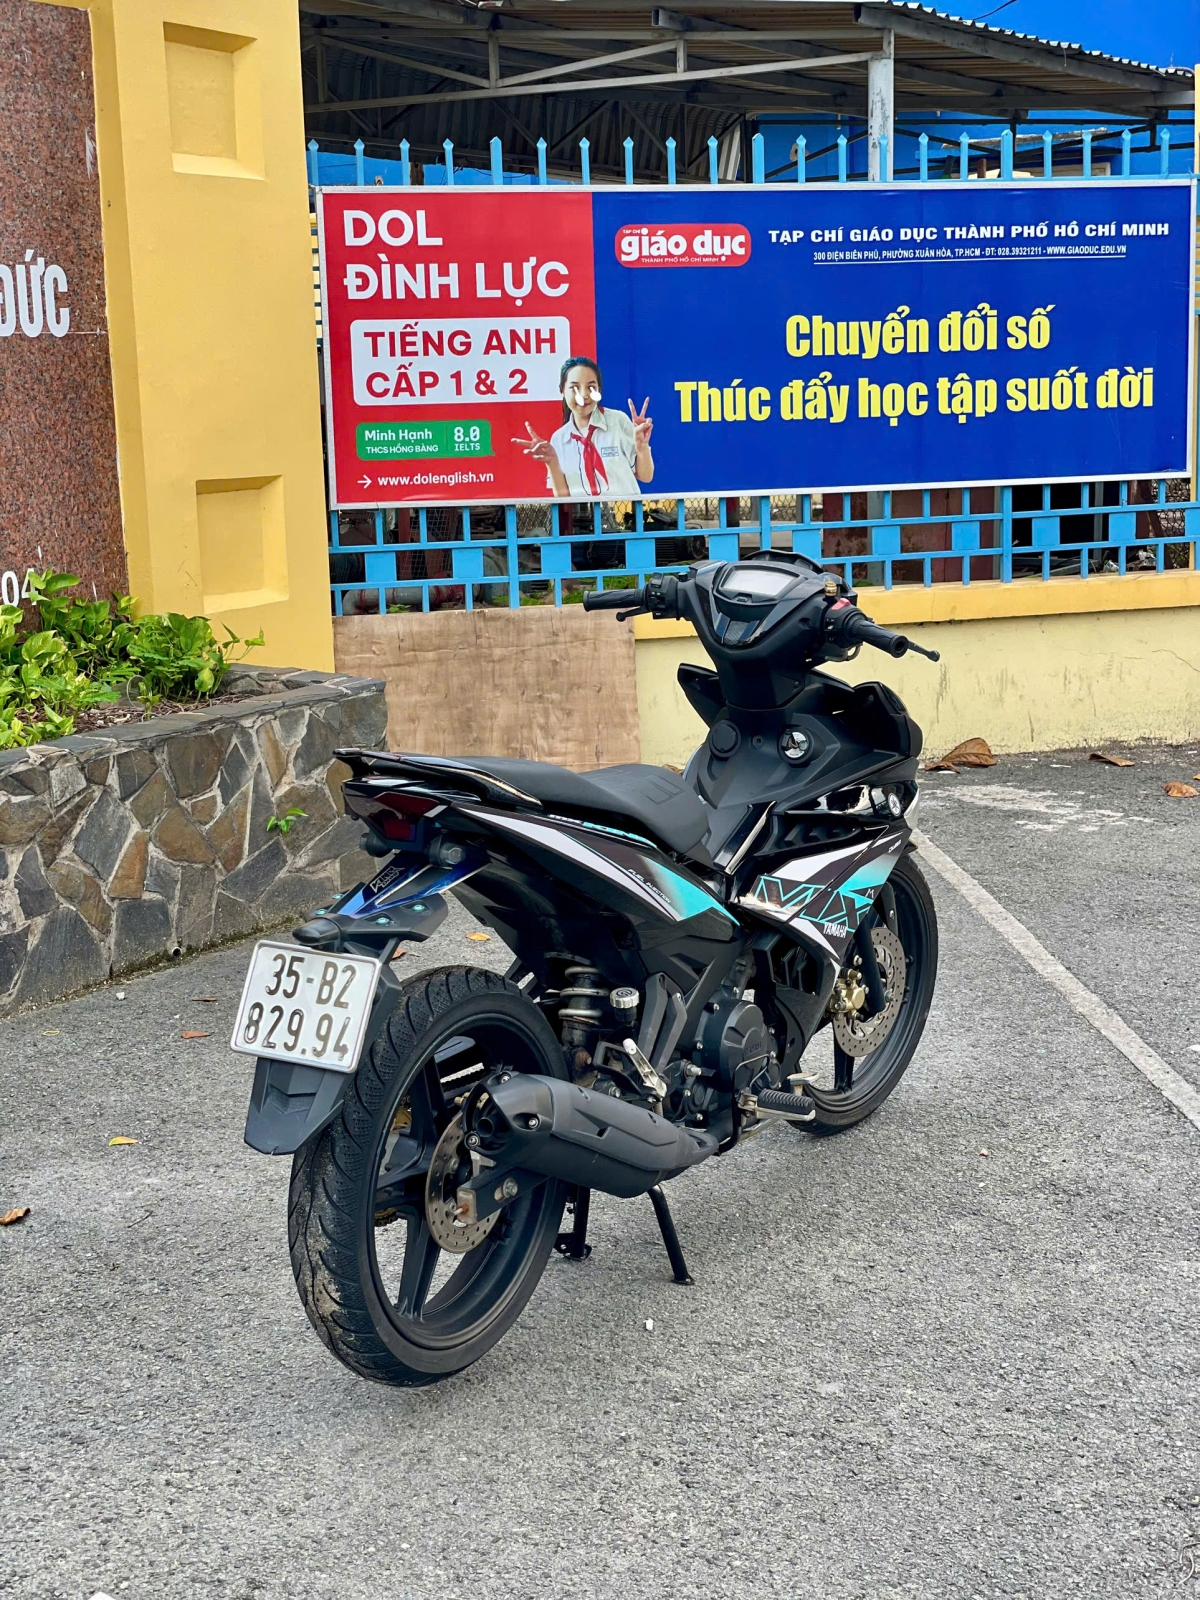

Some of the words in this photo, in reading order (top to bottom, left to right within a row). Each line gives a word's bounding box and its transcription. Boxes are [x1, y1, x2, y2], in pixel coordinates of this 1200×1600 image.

[343, 209, 444, 247] DOL
[621, 227, 688, 262] giáo
[692, 229, 746, 262] dục
[768, 230, 805, 245] TẠP
[810, 226, 845, 243] CHÍ
[849, 225, 894, 242] GIÁO
[900, 227, 938, 243] DỤC
[943, 223, 1005, 240] THÀNH
[1011, 220, 1050, 238] PHỐ
[1054, 220, 1080, 237] HỒ
[1084, 221, 1117, 237] CHÍ
[1121, 223, 1170, 236] MINH
[813, 252, 826, 261] 300
[915, 246, 935, 258] XUÂN
[936, 246, 954, 258] HÒA,
[955, 247, 981, 257] TP.HCM
[997, 246, 1042, 256] 028.39321211
[1046, 245, 1127, 255] WWW.GIAODUC.EDU.VN
[343, 253, 460, 300] ĐÌNH
[475, 255, 570, 307] LỰC
[363, 321, 473, 358] TIẾNG
[483, 328, 557, 356] ANH
[785, 305, 930, 360] Chuyển
[938, 302, 999, 352] đổi
[1006, 304, 1057, 350] số
[365, 361, 440, 399] CẤP
[449, 370, 464, 396] 1
[474, 370, 498, 396] &
[508, 368, 529, 395] 2
[674, 378, 771, 424] Thúc
[779, 371, 850, 424] đẩy
[857, 375, 929, 427] học
[936, 372, 998, 424] tập
[1005, 366, 1089, 412] suốt
[1096, 365, 1155, 410] đời
[364, 430, 396, 441] Minh
[399, 429, 433, 443] Hạnh
[365, 446, 388, 454] THCS
[415, 443, 439, 453] BÀNG
[454, 426, 480, 442] 8.0
[454, 443, 481, 452] IELTS
[377, 471, 494, 487] www.dolenglish.vn
[823, 922, 847, 939] YAMAHA
[265, 953, 357, 1009] 35-B2
[243, 1001, 352, 1062] 829.94
